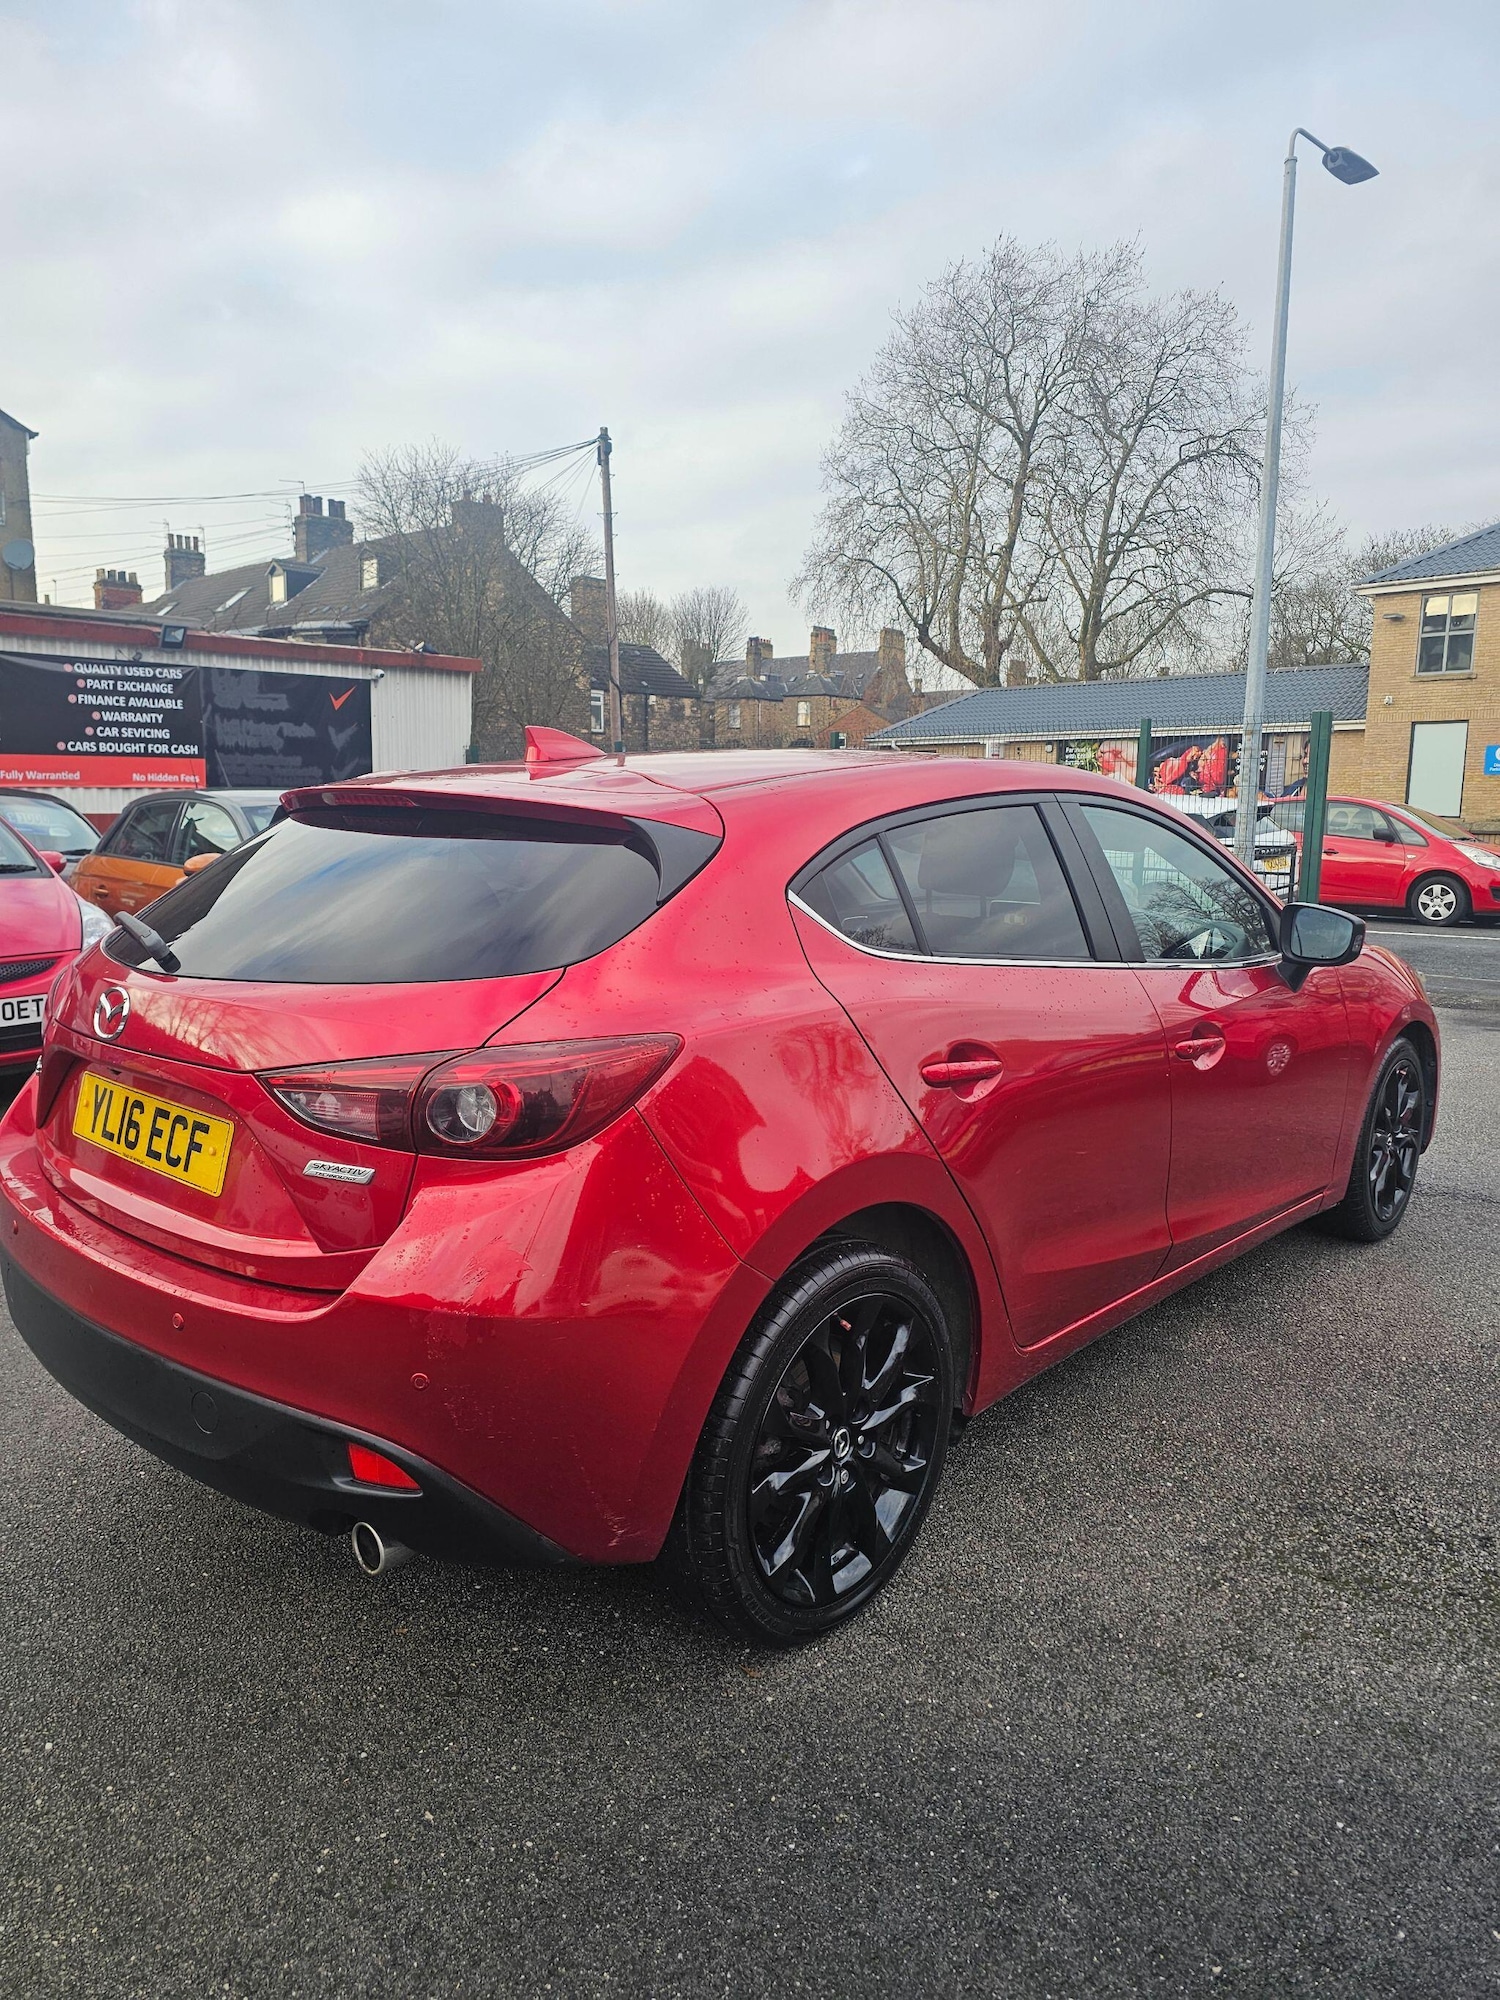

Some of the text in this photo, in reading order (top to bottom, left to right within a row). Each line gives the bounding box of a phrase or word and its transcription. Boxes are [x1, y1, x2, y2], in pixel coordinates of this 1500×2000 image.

[74, 662, 183, 679] QUALITY USED CARS
[86, 679, 173, 694] PART EXCHANGE
[78, 694, 183, 709] FINANCE AVALIABLE
[101, 711, 163, 723] WARRANTY
[97, 726, 170, 739] CAR SEVICING
[67, 741, 198, 755] CARS BOUGHT FOR CASH
[0, 770, 81, 781] Fully Warrantied
[132, 773, 199, 783] No Hidden Fees
[2, 998, 44, 1021] OET
[90, 1083, 210, 1173] YL16 ECF
[312, 1163, 366, 1175] SKYACTIV
